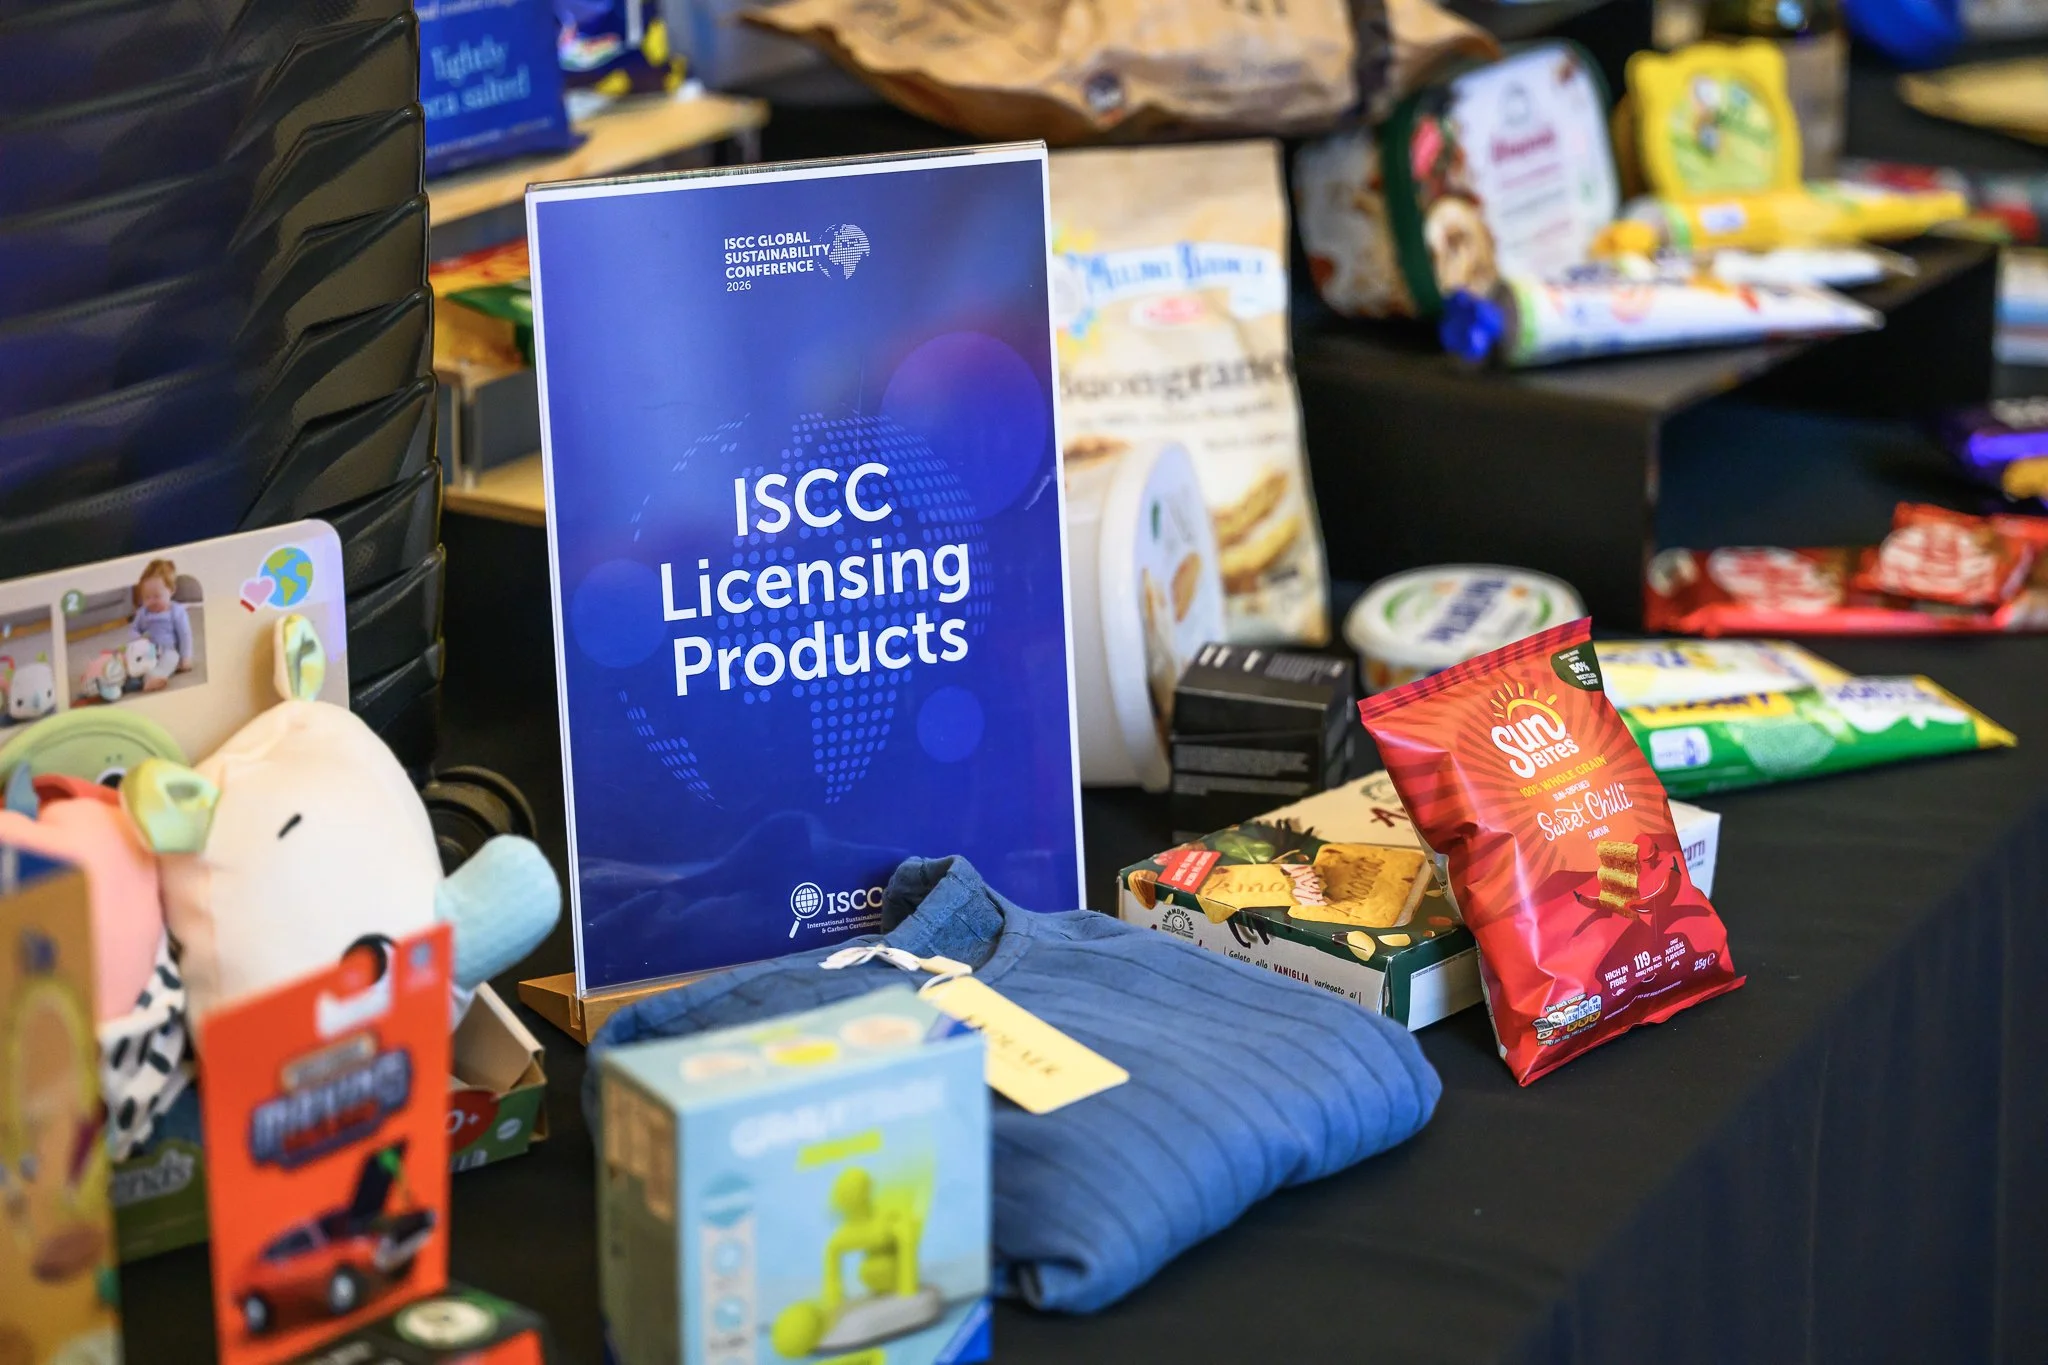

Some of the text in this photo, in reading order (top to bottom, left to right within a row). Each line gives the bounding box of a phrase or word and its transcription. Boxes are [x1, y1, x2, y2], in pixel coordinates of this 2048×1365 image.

[724, 231, 811, 250] ISCC GLOBAL
[724, 243, 831, 265] SUSTAINABILITY
[725, 260, 815, 279] CONFERENCE
[726, 280, 752, 292] 2026
[734, 462, 893, 537] ISCC
[660, 537, 971, 622] Licensing
[673, 612, 969, 697] Products
[1519, 784, 1542, 798] 100%
[1540, 769, 1577, 792] WHOLE
[1537, 782, 1633, 841] Sweet Chilli
[1587, 825, 1611, 841] FLAVOUR
[806, 913, 883, 929] International Sustainabilit
[827, 925, 848, 933] Carbon
[849, 920, 883, 930] Certificatio
[1162, 908, 1194, 931] SAMMONTANA
[1665, 941, 1685, 955] NATURAL
[1228, 950, 1251, 963] Gelato
[1255, 960, 1268, 969] alla
[1273, 964, 1309, 983] VANIGLIA
[1633, 950, 1651, 970] 119
[1605, 964, 1629, 981] HIGH IN
[1609, 975, 1628, 989] FIBRE
